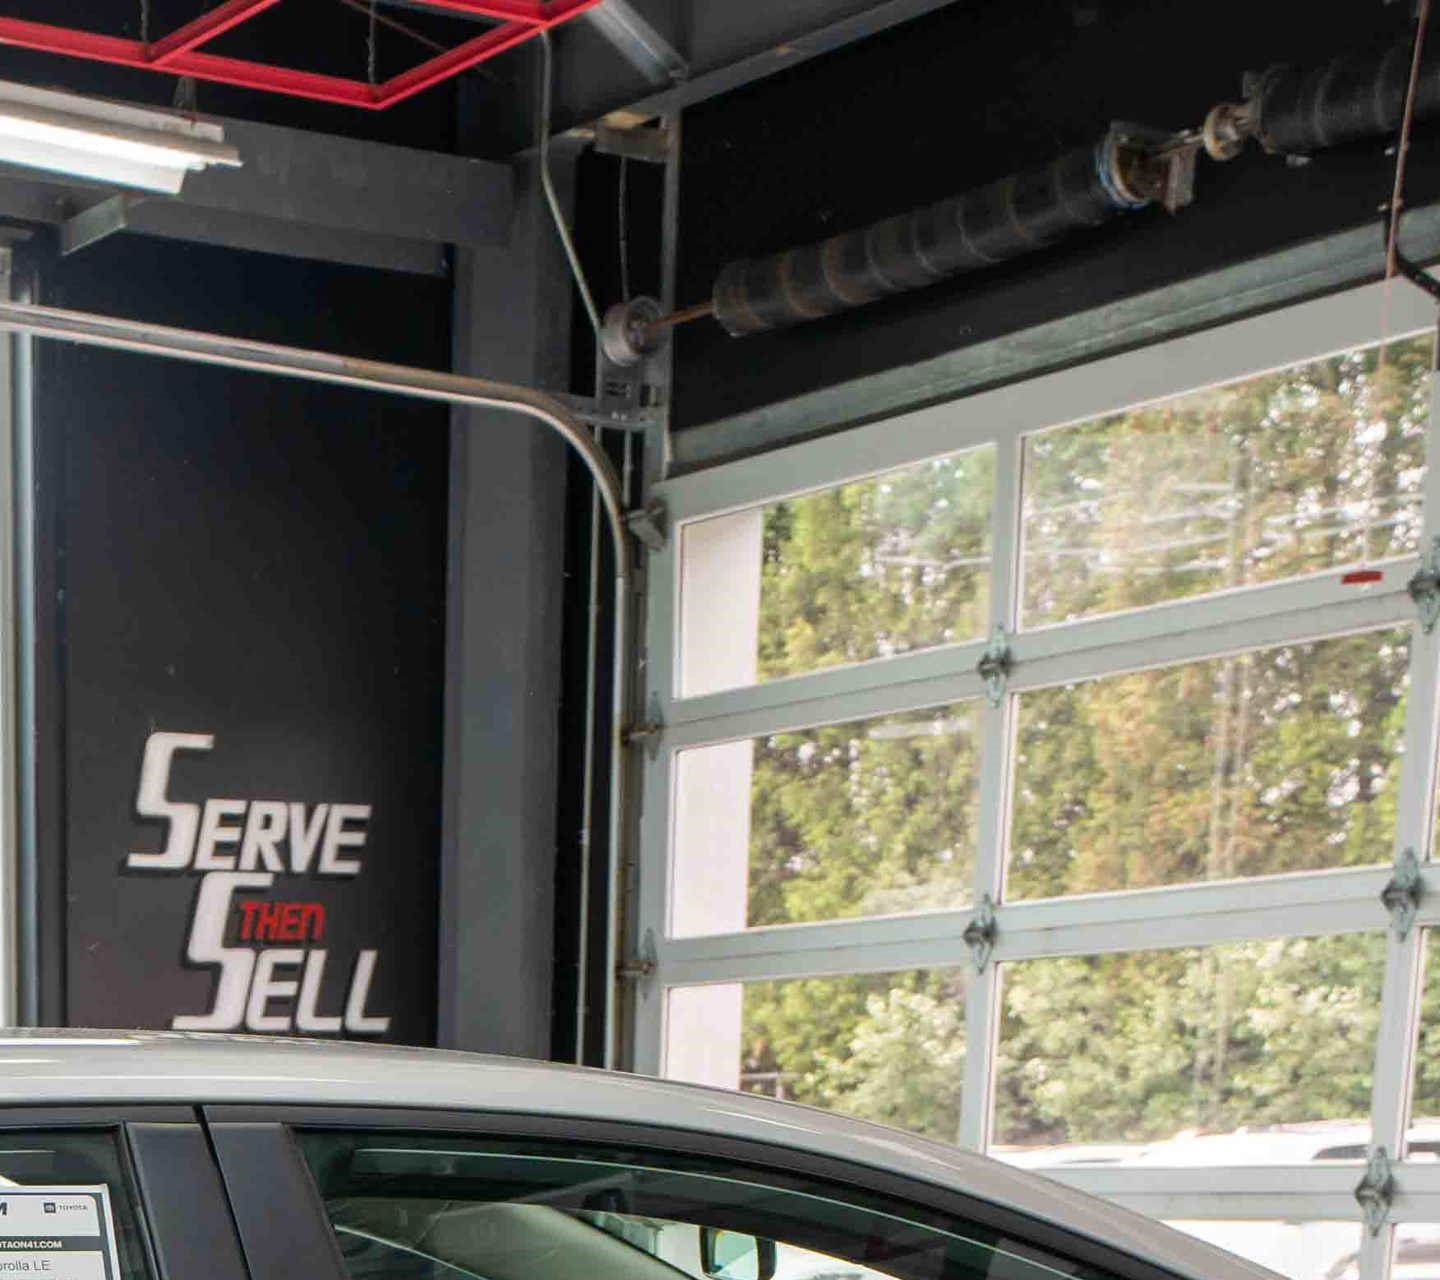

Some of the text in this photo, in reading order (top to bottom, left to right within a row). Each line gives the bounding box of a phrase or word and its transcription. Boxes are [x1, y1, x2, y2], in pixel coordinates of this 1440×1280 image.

[126, 732, 372, 874] SERVE
[171, 871, 391, 1032] SELL
[238, 901, 325, 940] THEN
[32, 1259, 51, 1271] LE
